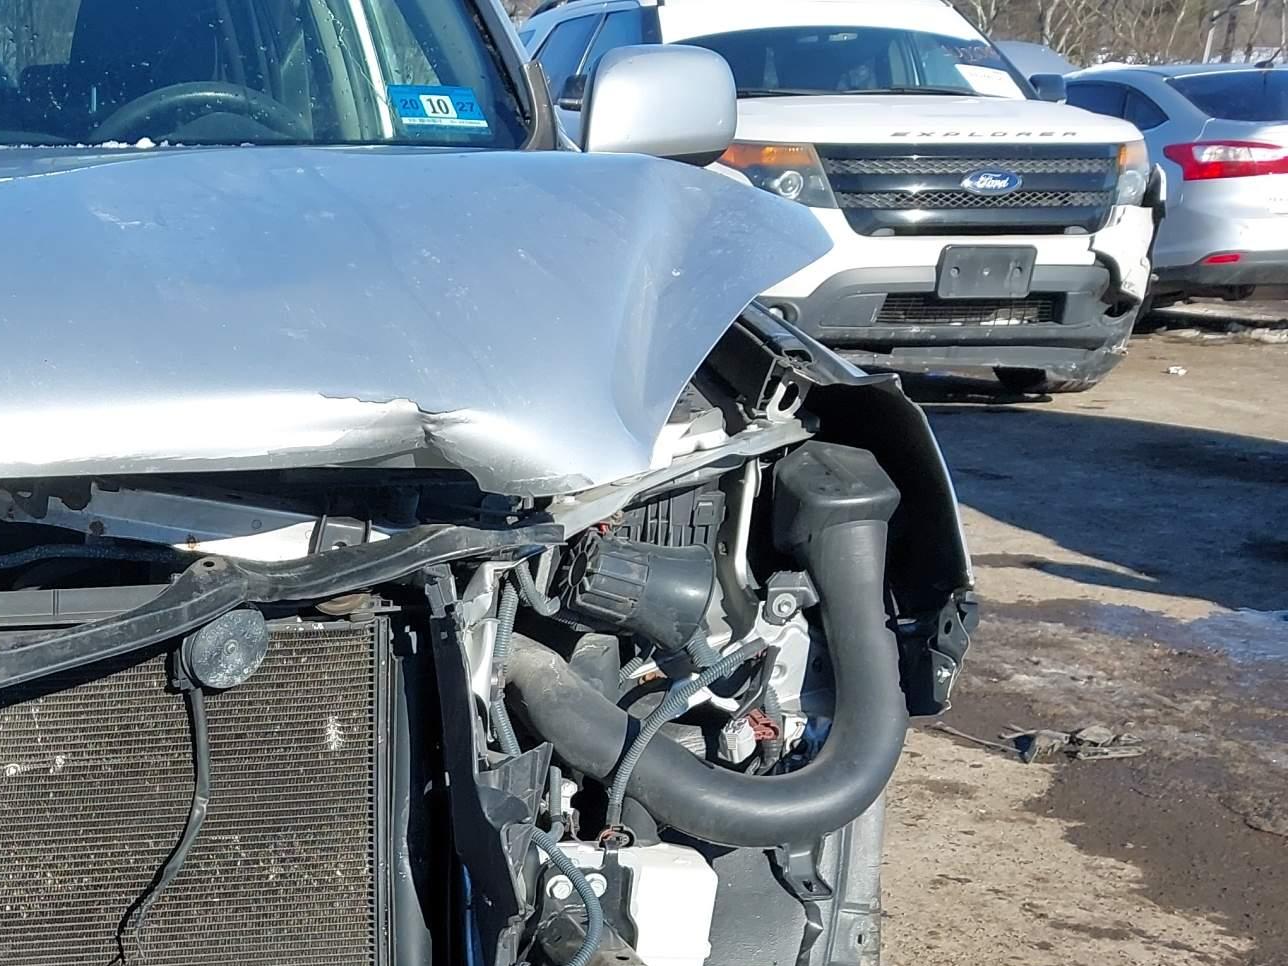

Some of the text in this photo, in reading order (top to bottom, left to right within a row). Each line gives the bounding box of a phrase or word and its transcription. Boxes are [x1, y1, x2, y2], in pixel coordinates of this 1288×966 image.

[399, 97, 475, 115] 20 10 27
[889, 130, 1078, 138] EXPLORER
[976, 172, 1010, 190] Ford
